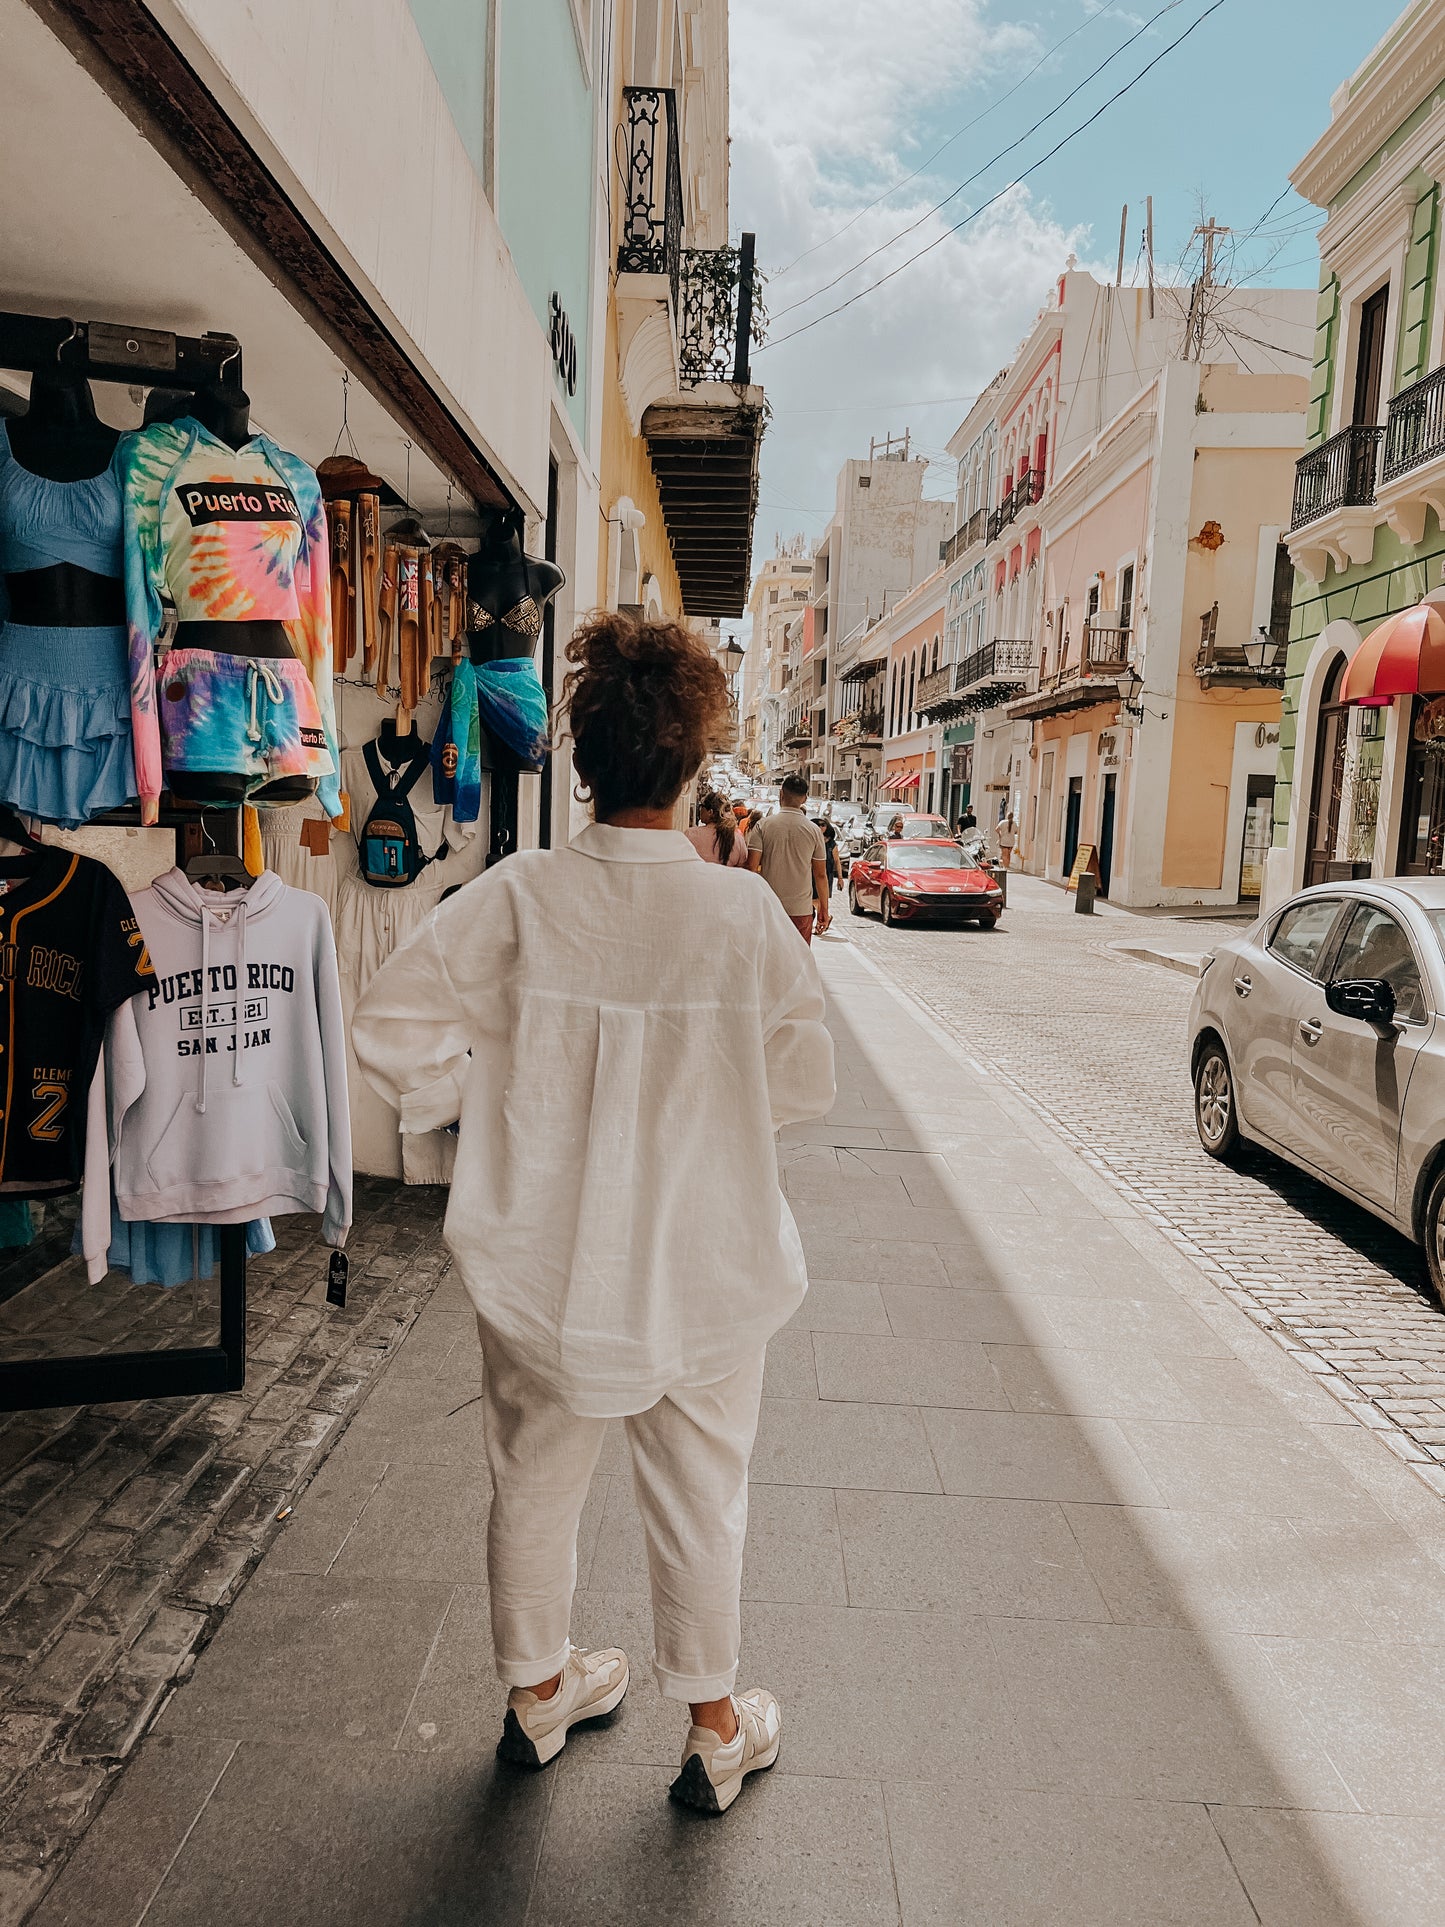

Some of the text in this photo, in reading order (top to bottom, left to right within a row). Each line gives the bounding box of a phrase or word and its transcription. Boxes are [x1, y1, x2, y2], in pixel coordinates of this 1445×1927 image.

[186, 490, 263, 516] Puerto
[298, 730, 318, 744] Puerto
[126, 931, 156, 977] 2
[148, 963, 295, 1011] PUERTO RICO
[231, 1002, 262, 1021] 121
[177, 1037, 219, 1057] SAN
[27, 1081, 69, 1142] 2
